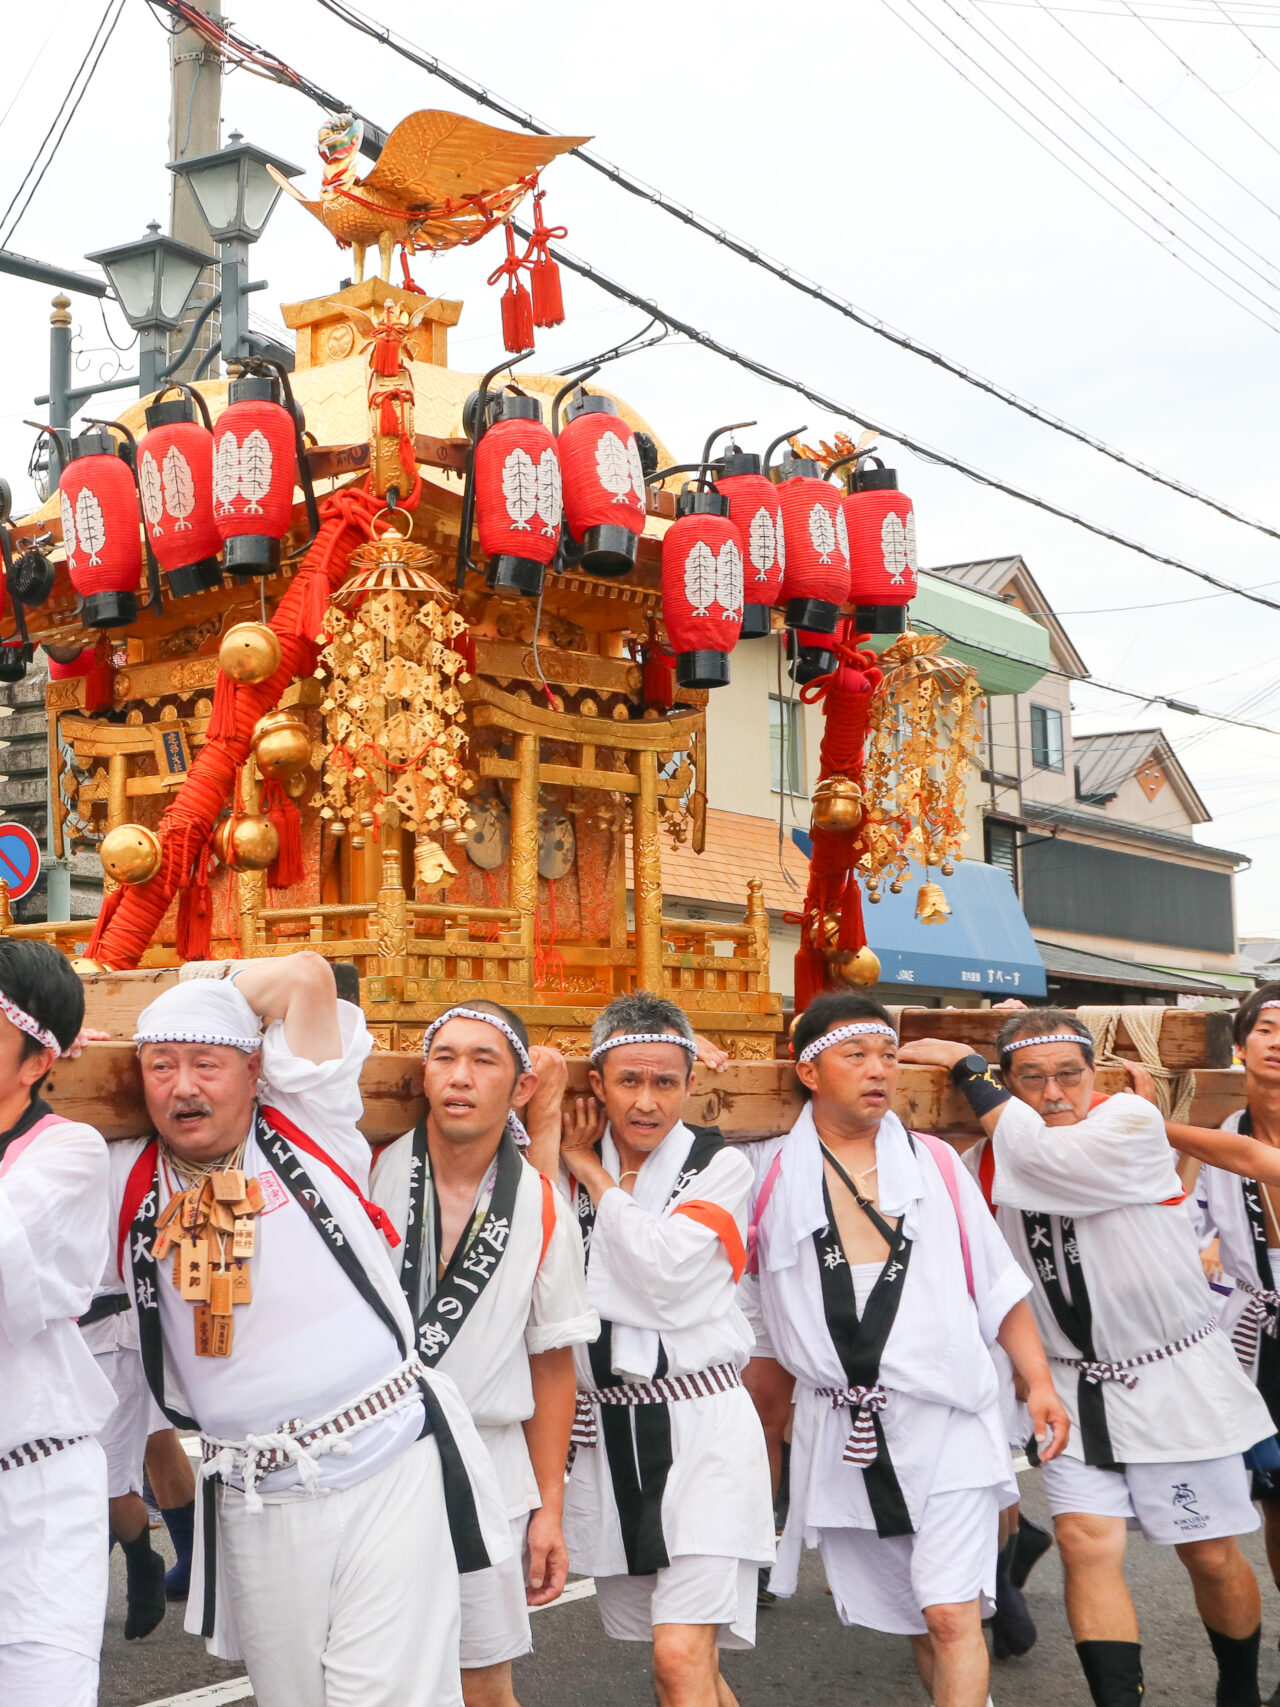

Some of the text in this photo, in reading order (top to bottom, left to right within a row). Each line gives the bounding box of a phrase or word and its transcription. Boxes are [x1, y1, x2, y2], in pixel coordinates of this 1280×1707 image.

[418, 1212, 510, 1357] 近江一の宮
